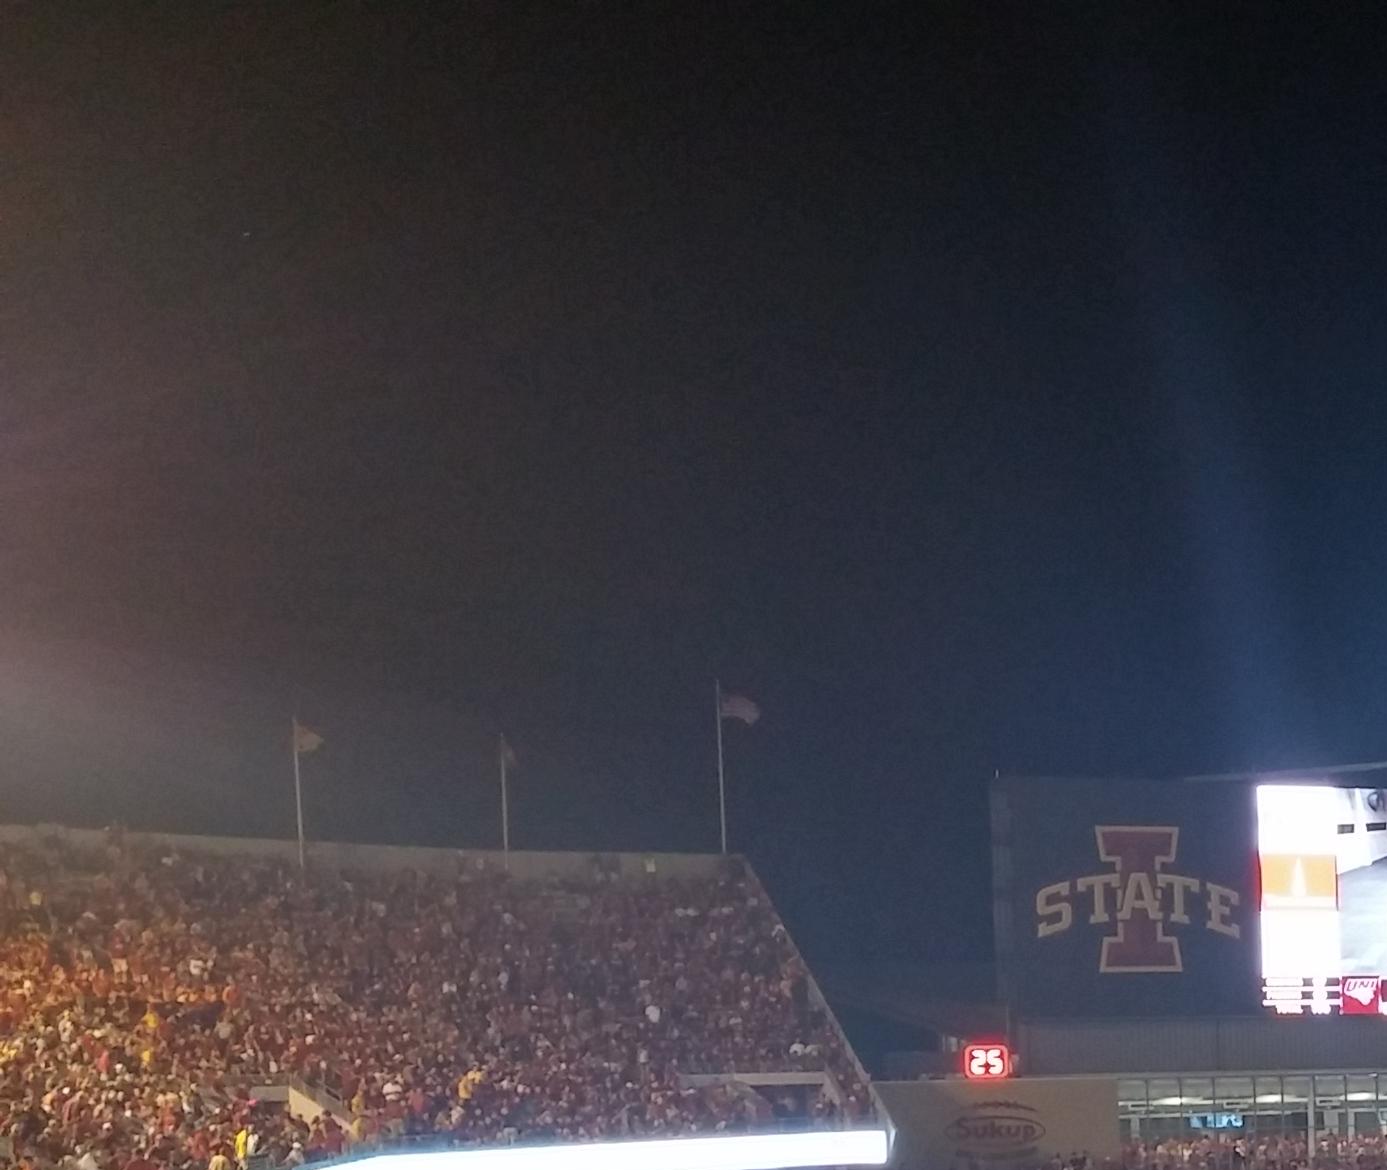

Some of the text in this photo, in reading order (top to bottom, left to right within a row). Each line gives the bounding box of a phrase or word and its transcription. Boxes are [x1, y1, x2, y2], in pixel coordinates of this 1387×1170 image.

[1036, 872, 1240, 938] STATE
[970, 1049, 1004, 1076] 25
[956, 1117, 1037, 1144] Sukup
